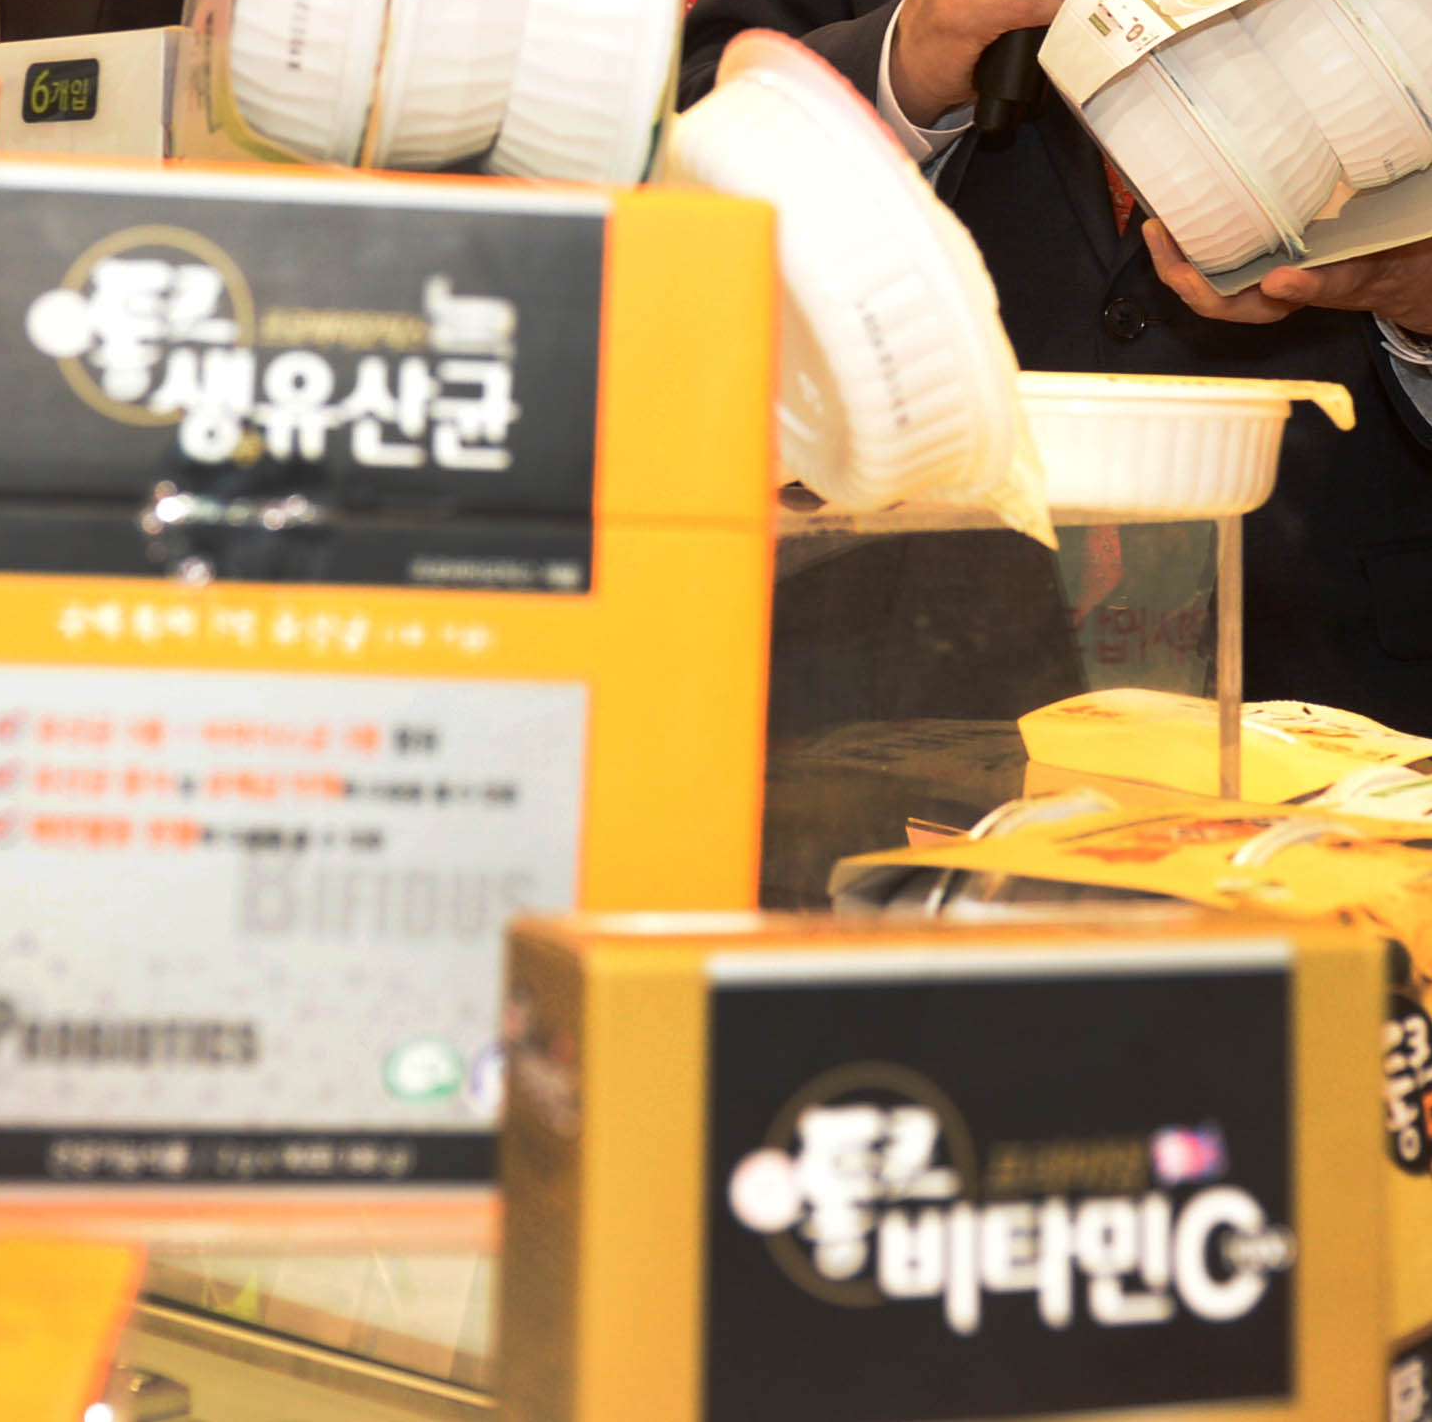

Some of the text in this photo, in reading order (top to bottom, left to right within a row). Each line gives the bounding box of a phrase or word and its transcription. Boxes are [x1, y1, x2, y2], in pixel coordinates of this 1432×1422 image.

[28, 64, 90, 115] 6개입
[87, 258, 242, 402] 통큰
[148, 348, 520, 470] 생유산균
[795, 1103, 962, 1280] 통큰
[878, 1183, 1270, 1338] 비타민C
